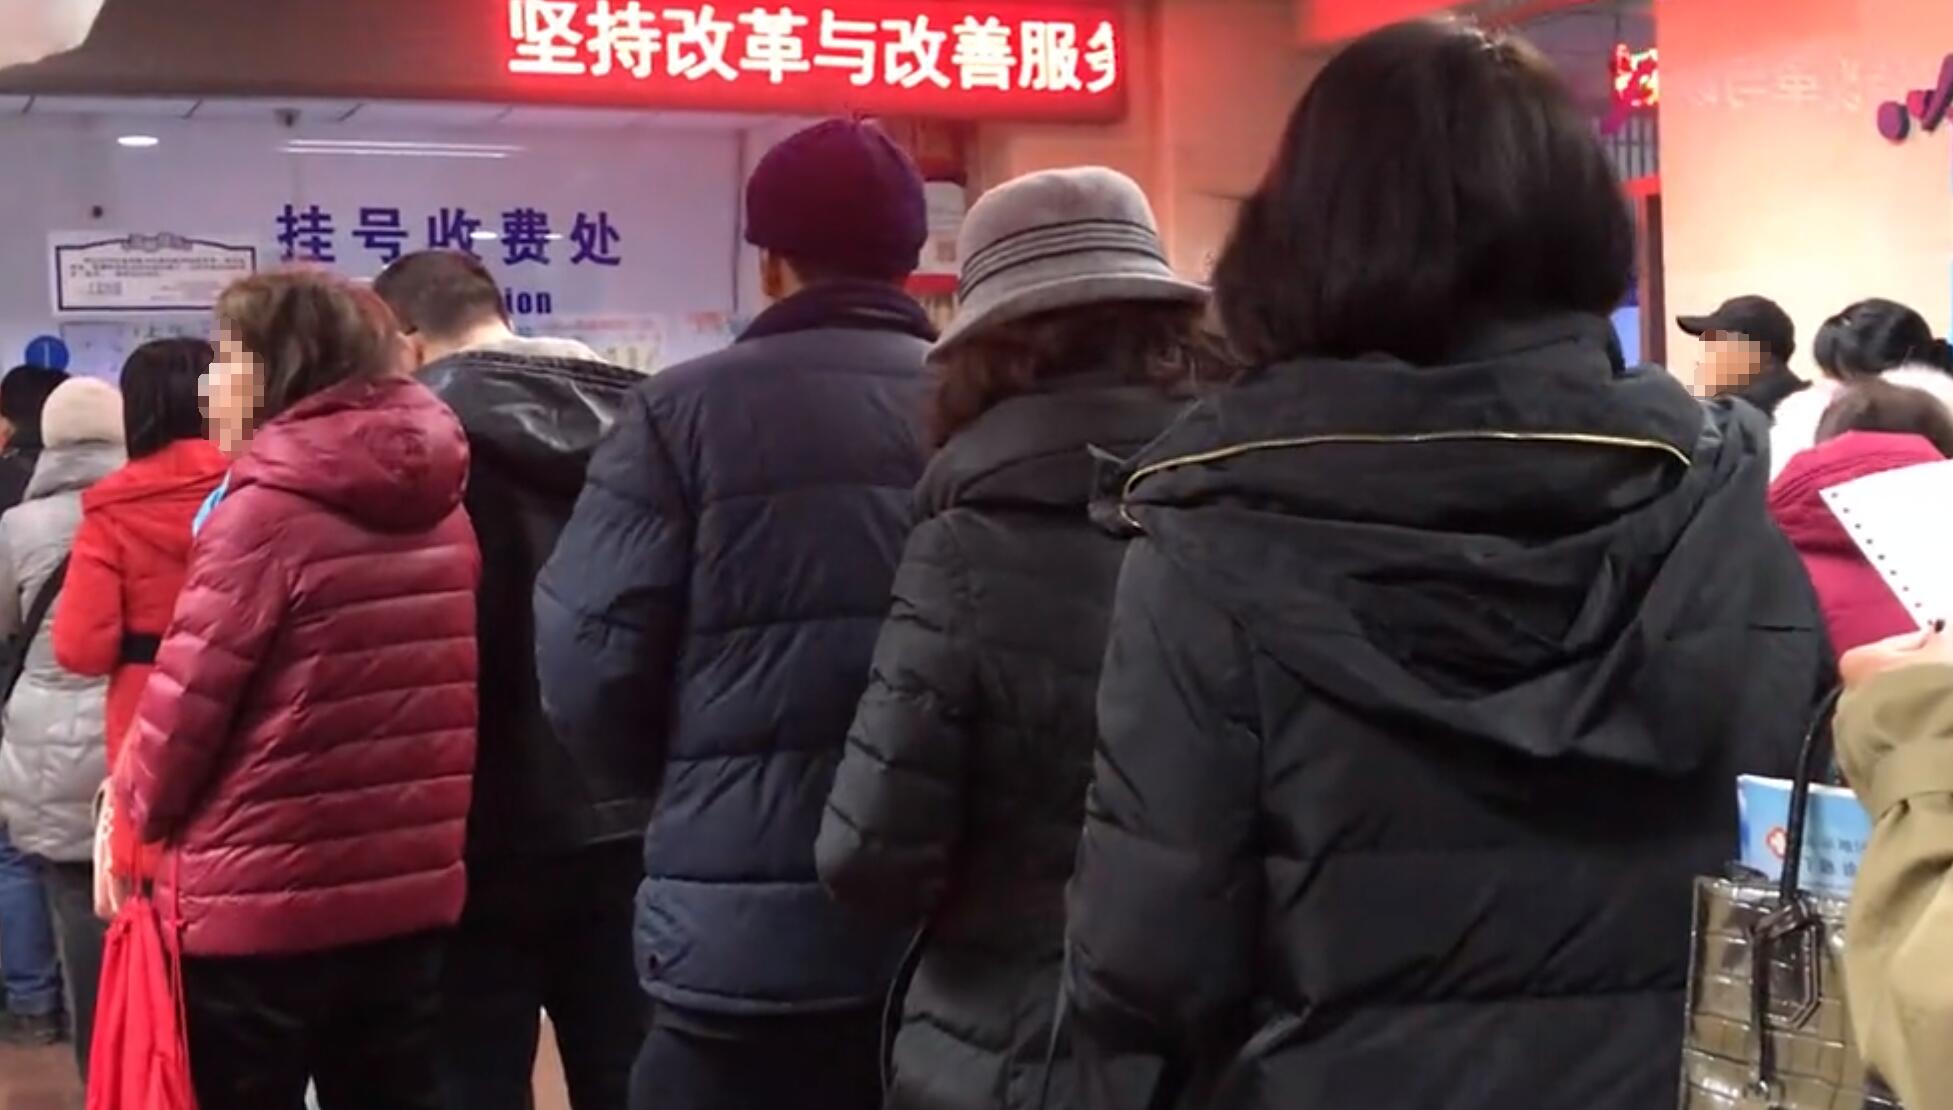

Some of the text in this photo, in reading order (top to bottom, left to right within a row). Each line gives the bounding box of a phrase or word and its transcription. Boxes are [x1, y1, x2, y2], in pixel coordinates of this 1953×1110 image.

[276, 204, 622, 267] 挂号收费处
